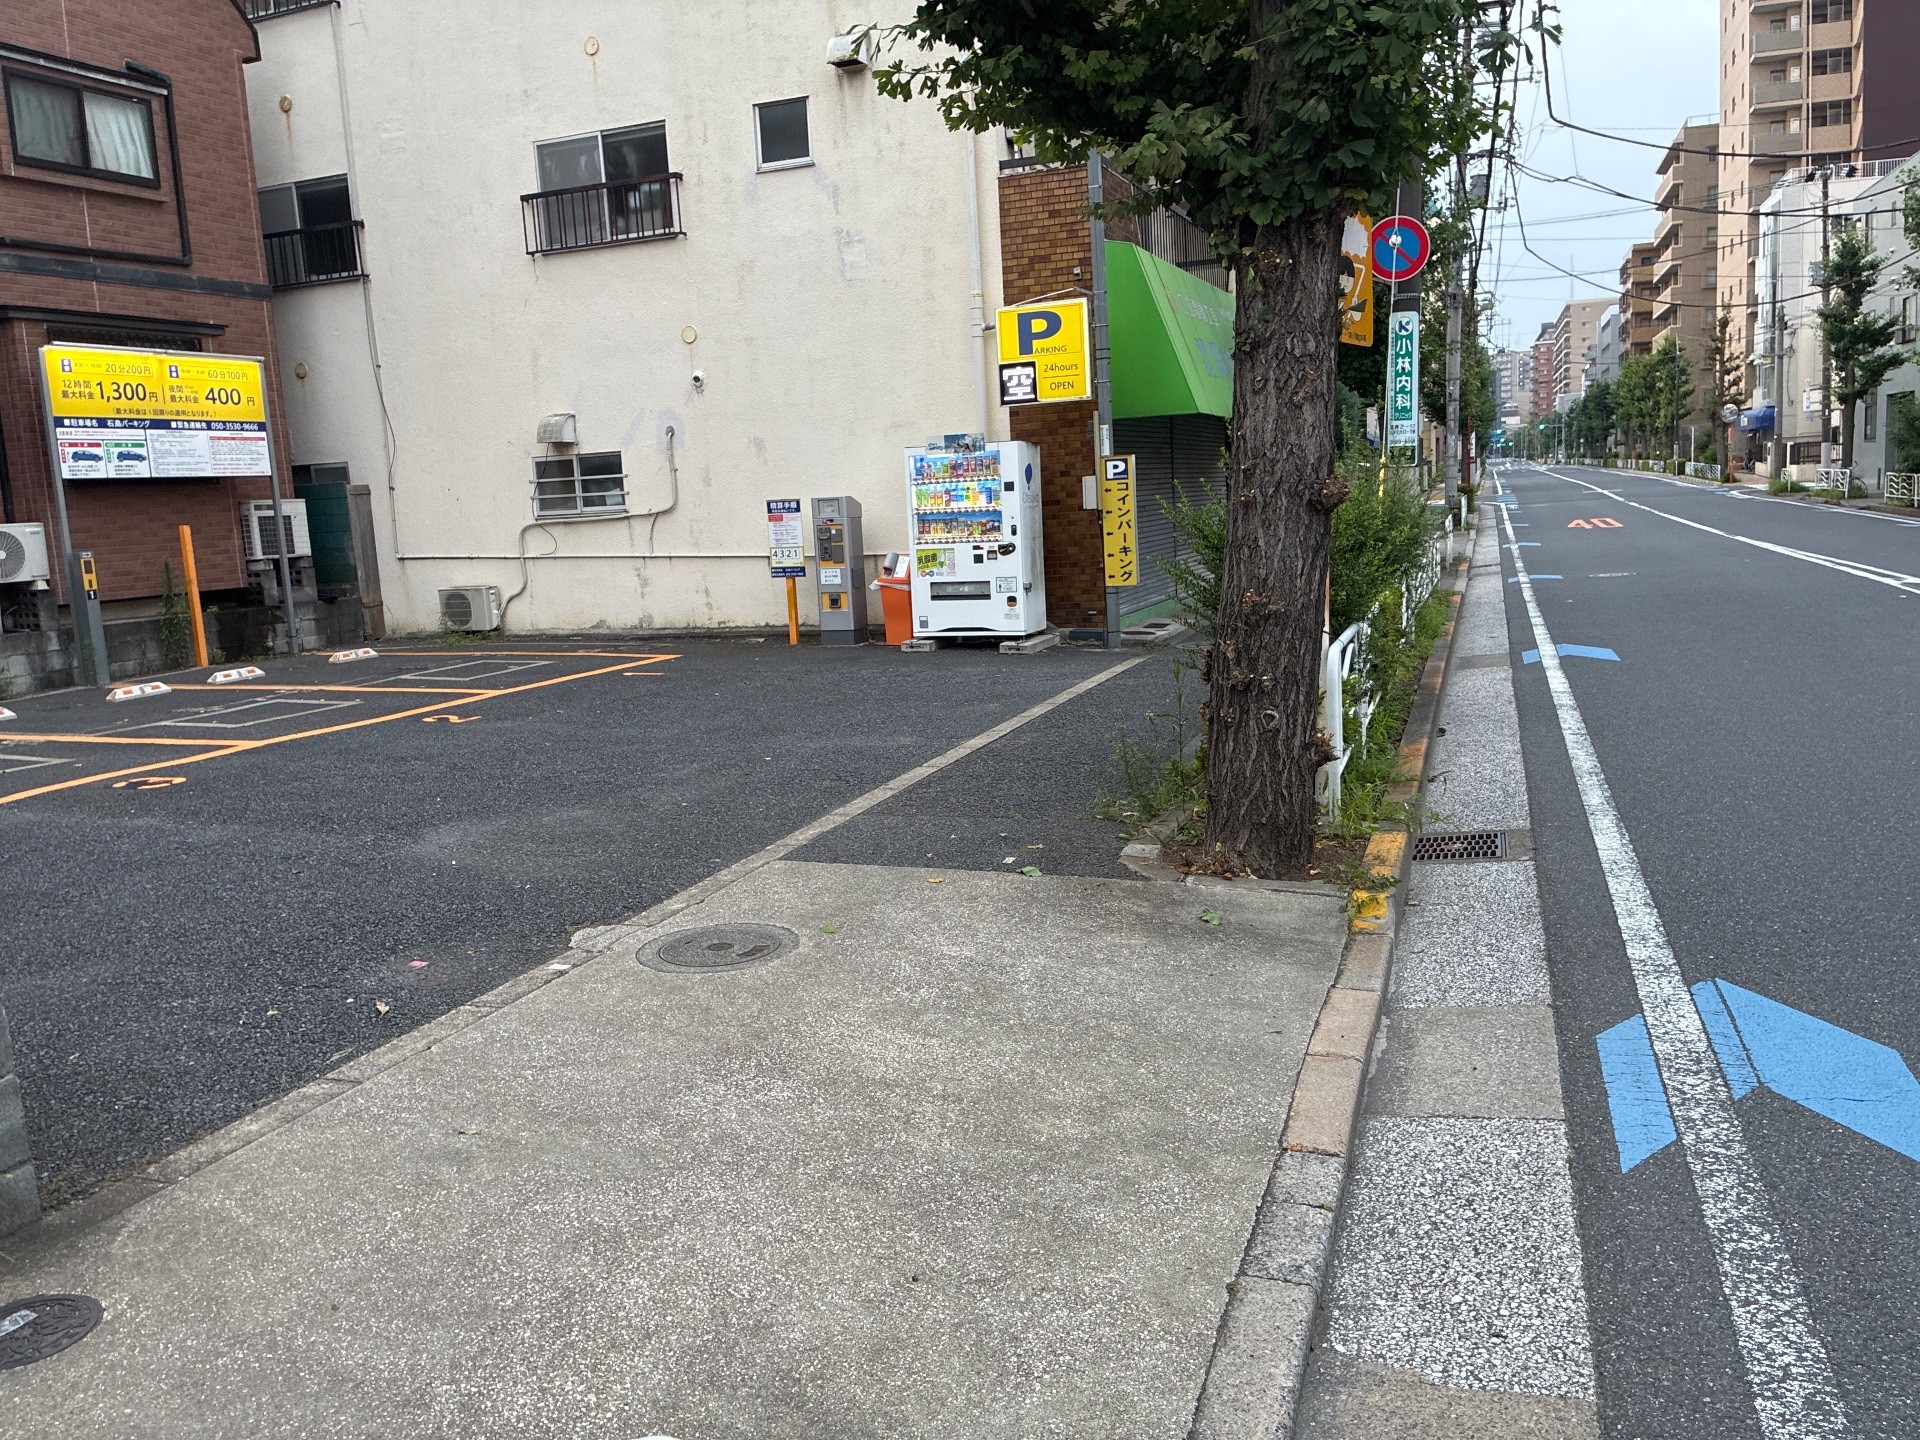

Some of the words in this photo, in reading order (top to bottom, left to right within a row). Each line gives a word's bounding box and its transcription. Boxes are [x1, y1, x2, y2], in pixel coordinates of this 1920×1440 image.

[105, 363, 151, 375] 20分200円
[1044, 363, 1079, 373] 24hours
[208, 370, 248, 381] 60分100円
[1396, 338, 1411, 410] 小林内科
[62, 379, 92, 390] 12時間
[168, 384, 184, 394] 夜間
[1003, 366, 1036, 401] 空
[1050, 381, 1074, 391] OPEN
[61, 389, 95, 400] 最大料金
[95, 380, 158, 403] 1,300円
[205, 387, 255, 406] 400円
[169, 394, 200, 404] 最大料金
[1395, 412, 1412, 420] クリニック
[1106, 461, 1126, 479] P
[1567, 517, 1624, 529] 40
[1117, 482, 1133, 582] コインパーキング
[772, 549, 798, 558] 4321
